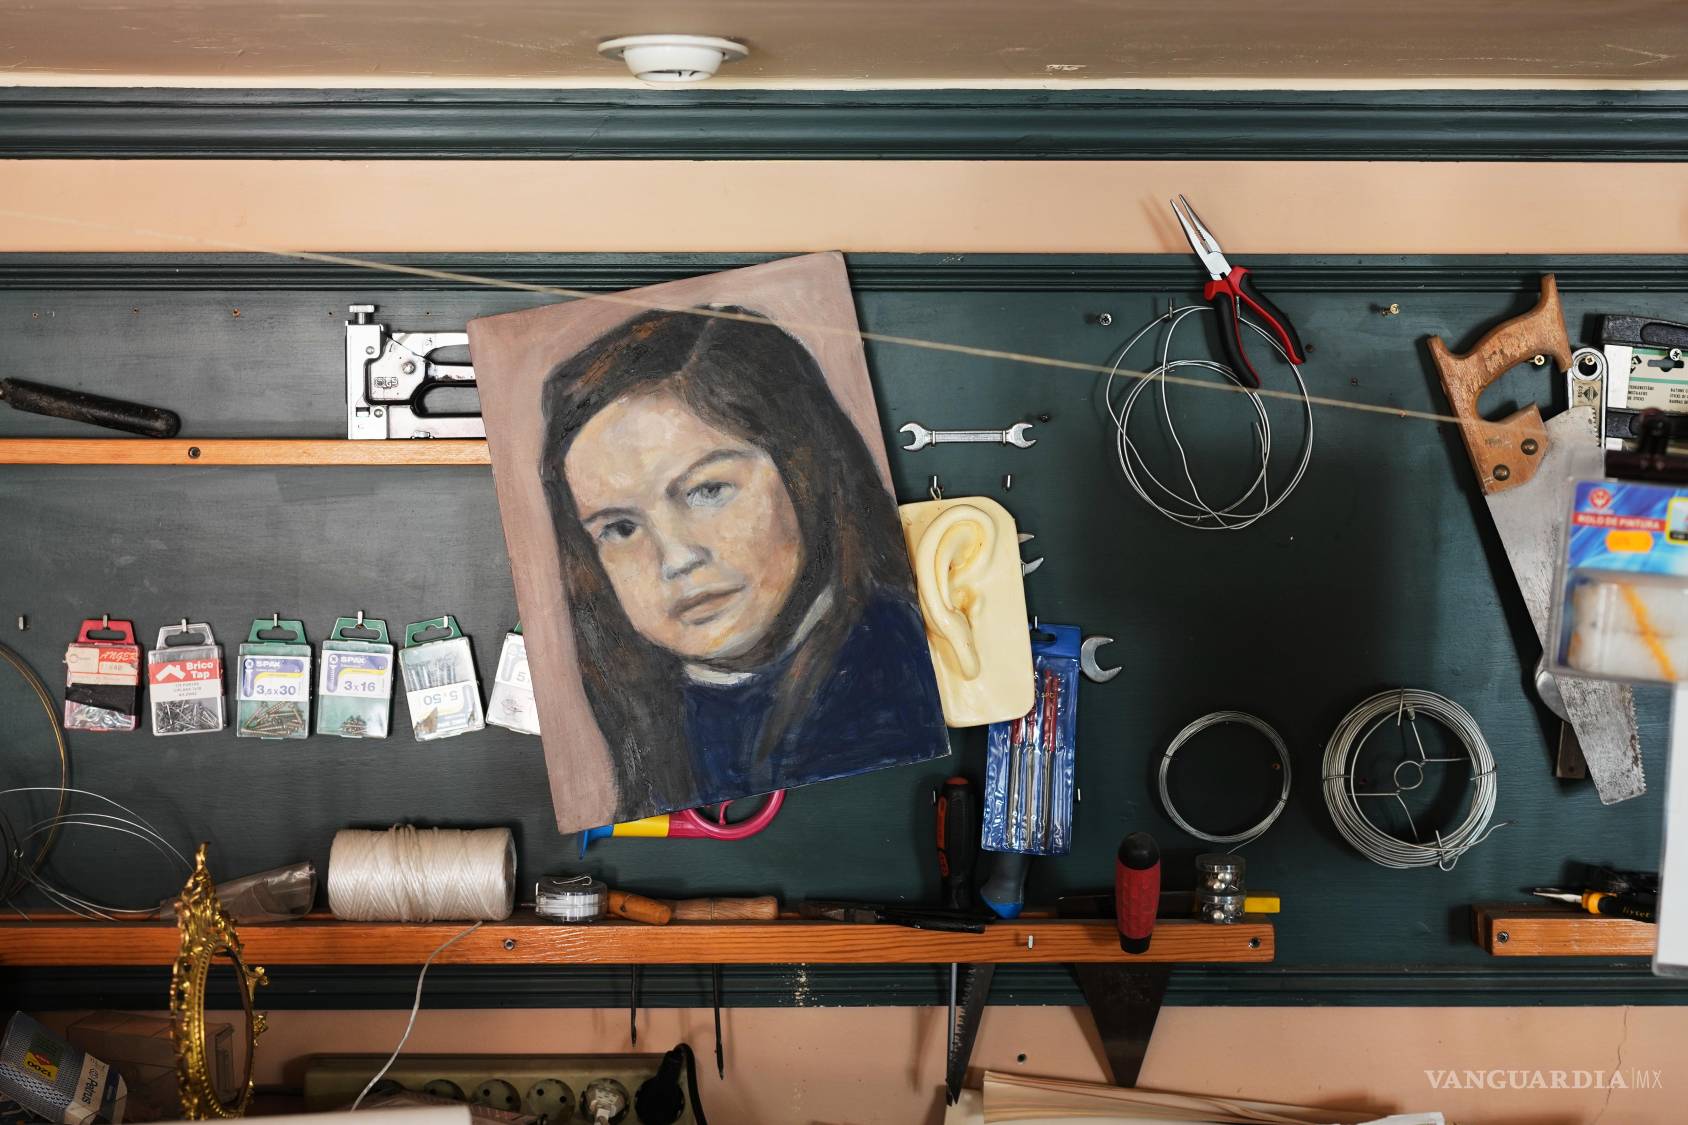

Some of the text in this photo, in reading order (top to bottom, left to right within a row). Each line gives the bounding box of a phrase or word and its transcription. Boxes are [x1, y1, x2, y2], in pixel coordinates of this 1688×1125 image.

[1604, 516, 1617, 526] DE
[1619, 518, 1660, 530] PINTURA
[255, 659, 281, 668] SPAX
[340, 655, 367, 664] SPAX
[186, 661, 214, 671] Brico
[190, 670, 210, 680] Tap
[81, 1077, 98, 1105] Petrus
